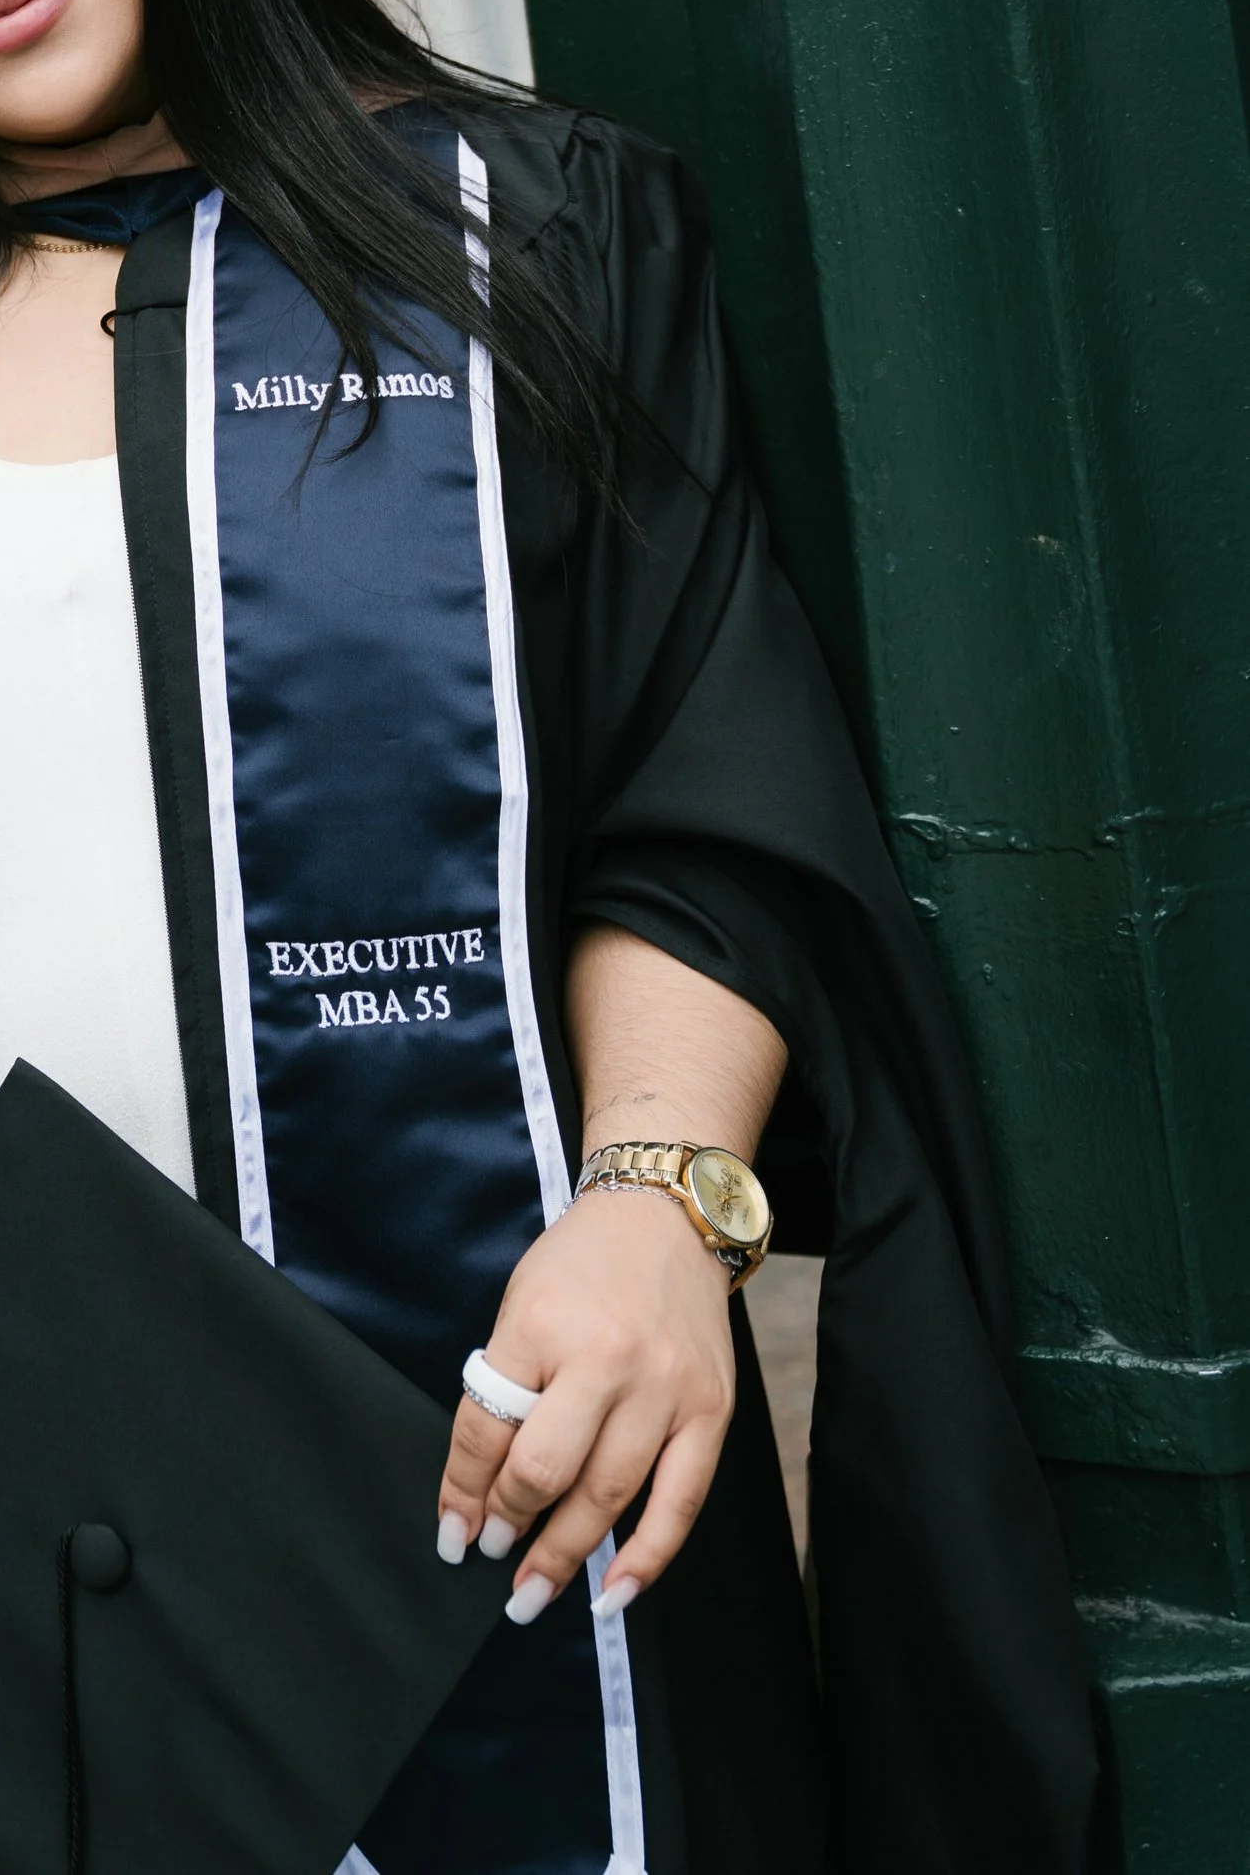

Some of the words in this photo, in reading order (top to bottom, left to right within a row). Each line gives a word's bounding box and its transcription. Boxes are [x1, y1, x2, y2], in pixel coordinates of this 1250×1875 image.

[231, 374, 332, 413] Milly
[265, 927, 486, 978] EXECUTIVE
[314, 988, 411, 1030] MBA
[413, 984, 453, 1022] 55
